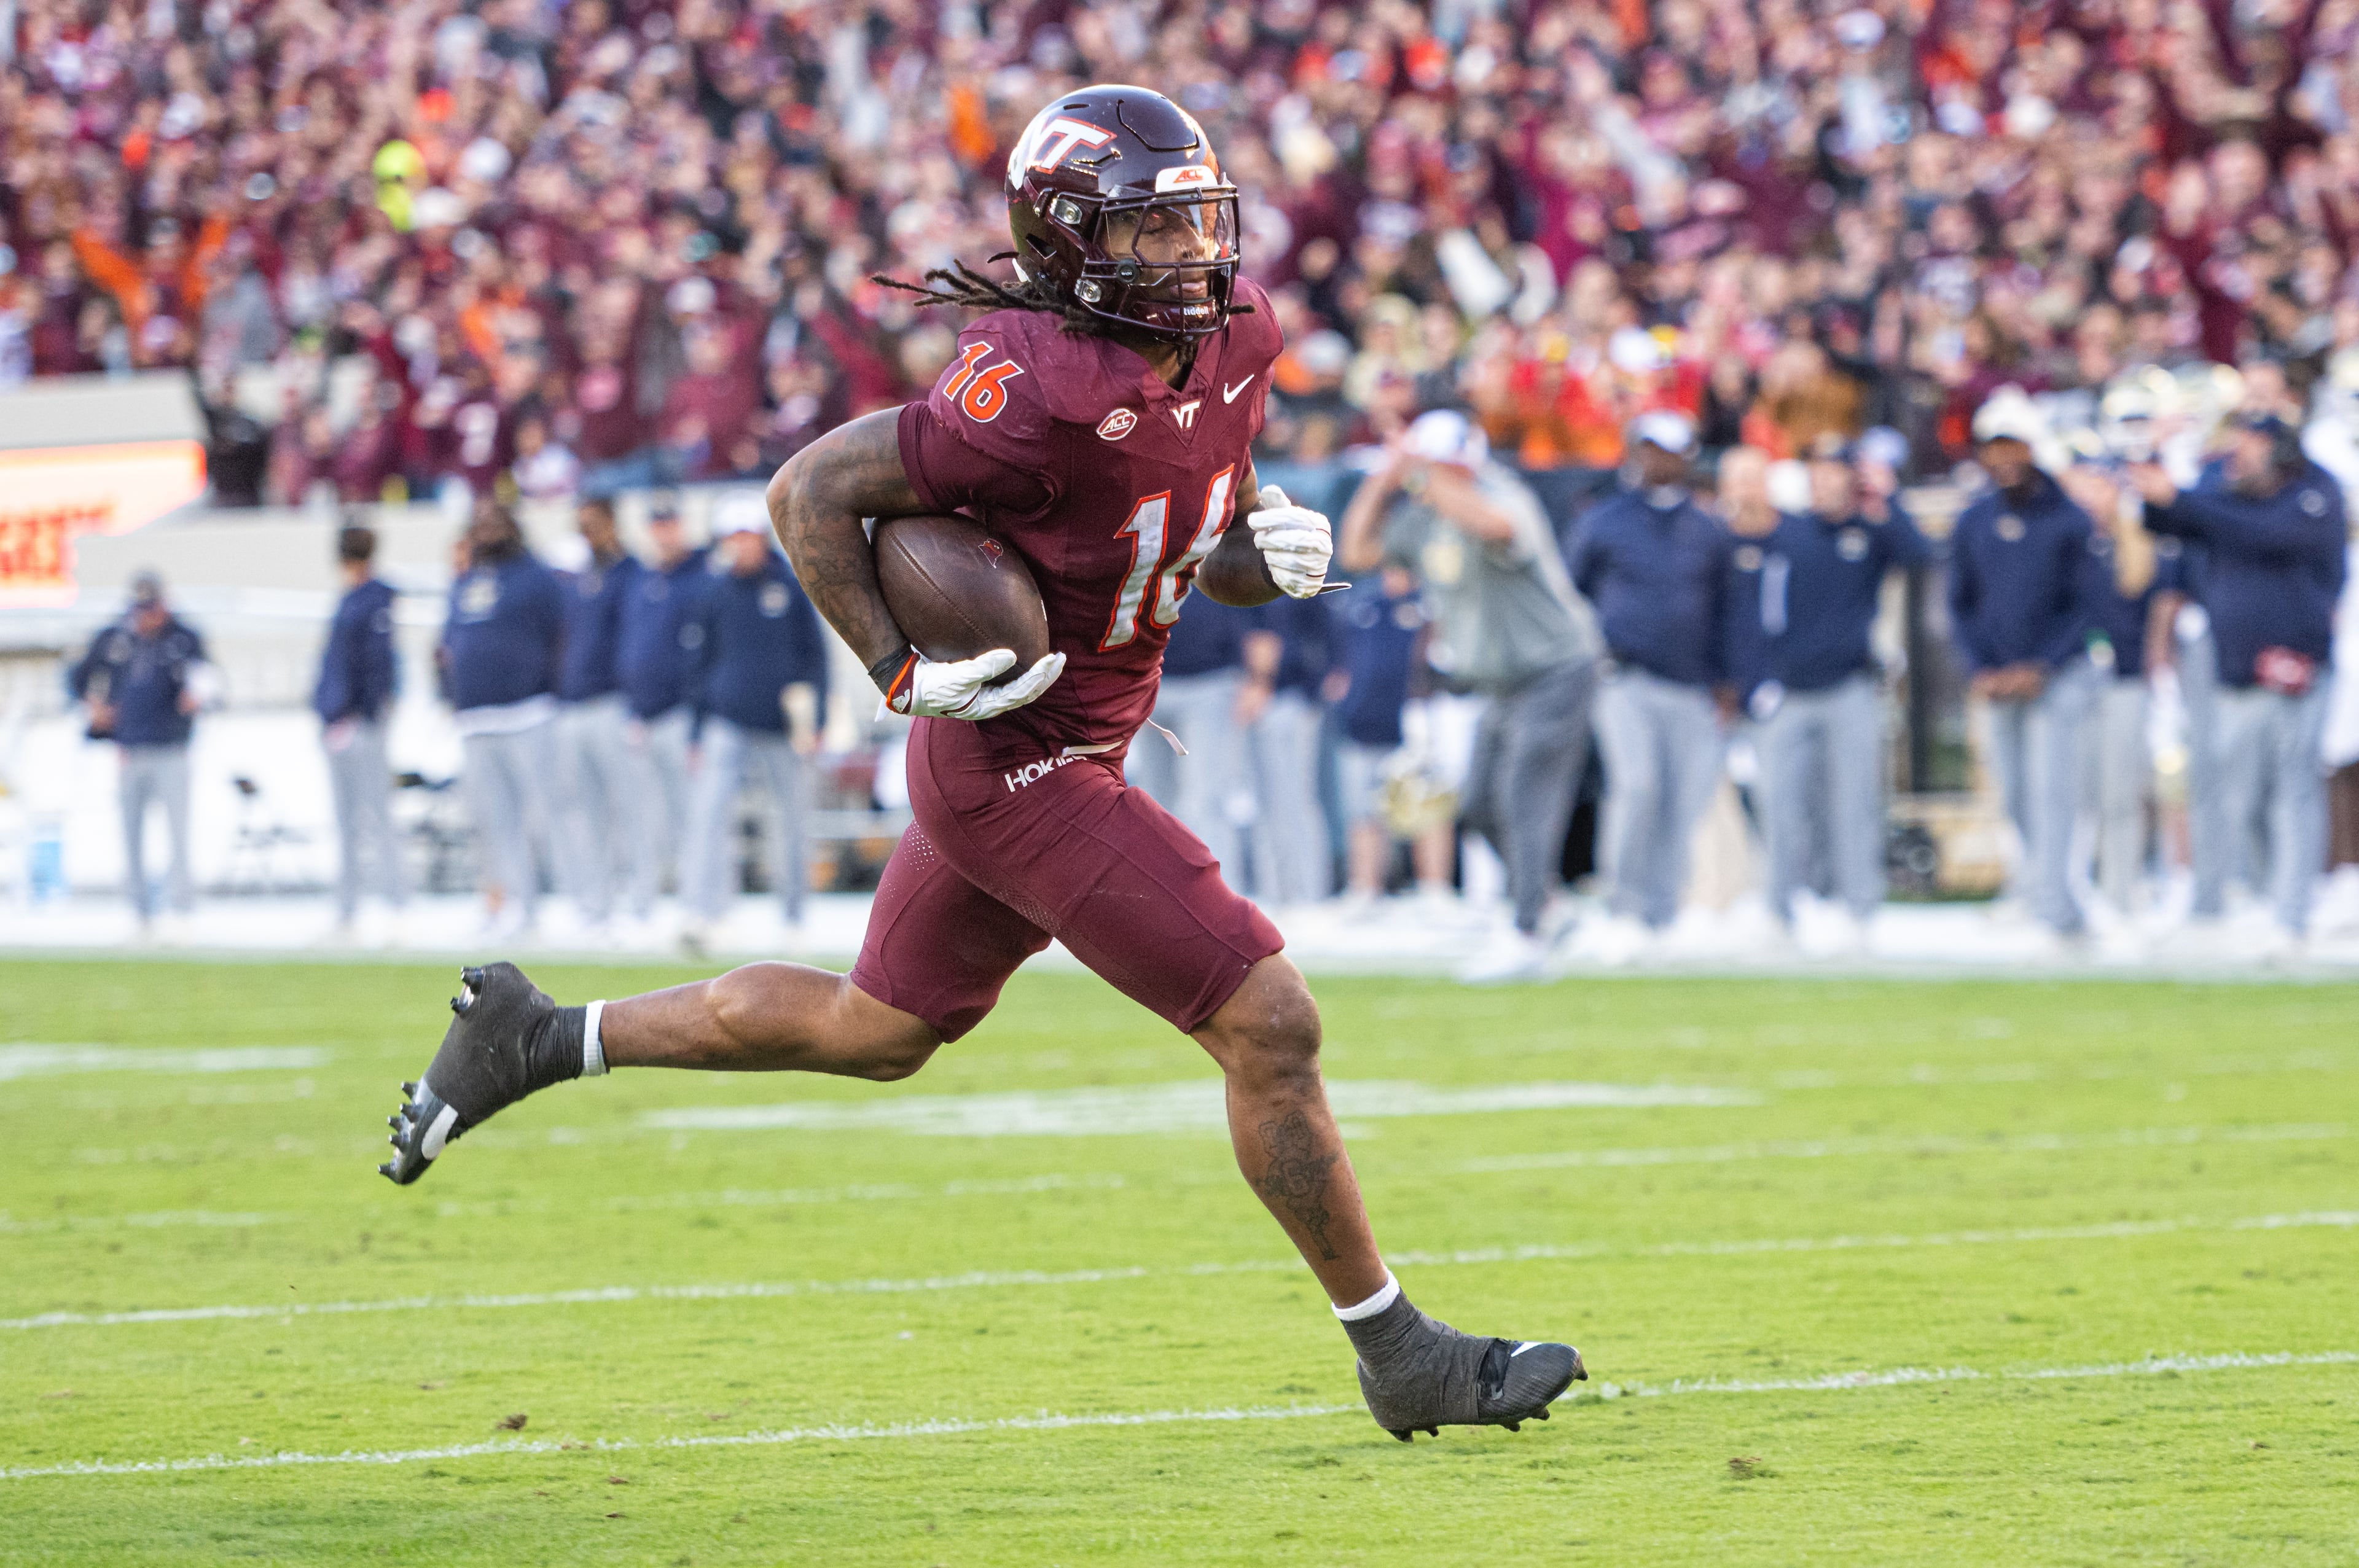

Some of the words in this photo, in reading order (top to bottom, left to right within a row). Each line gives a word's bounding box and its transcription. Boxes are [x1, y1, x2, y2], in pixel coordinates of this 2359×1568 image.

[1173, 168, 1203, 184] ACC
[943, 341, 1025, 423] 16
[1101, 412, 1132, 433] ACC
[1169, 399, 1202, 432] VT
[1098, 463, 1235, 652] 16
